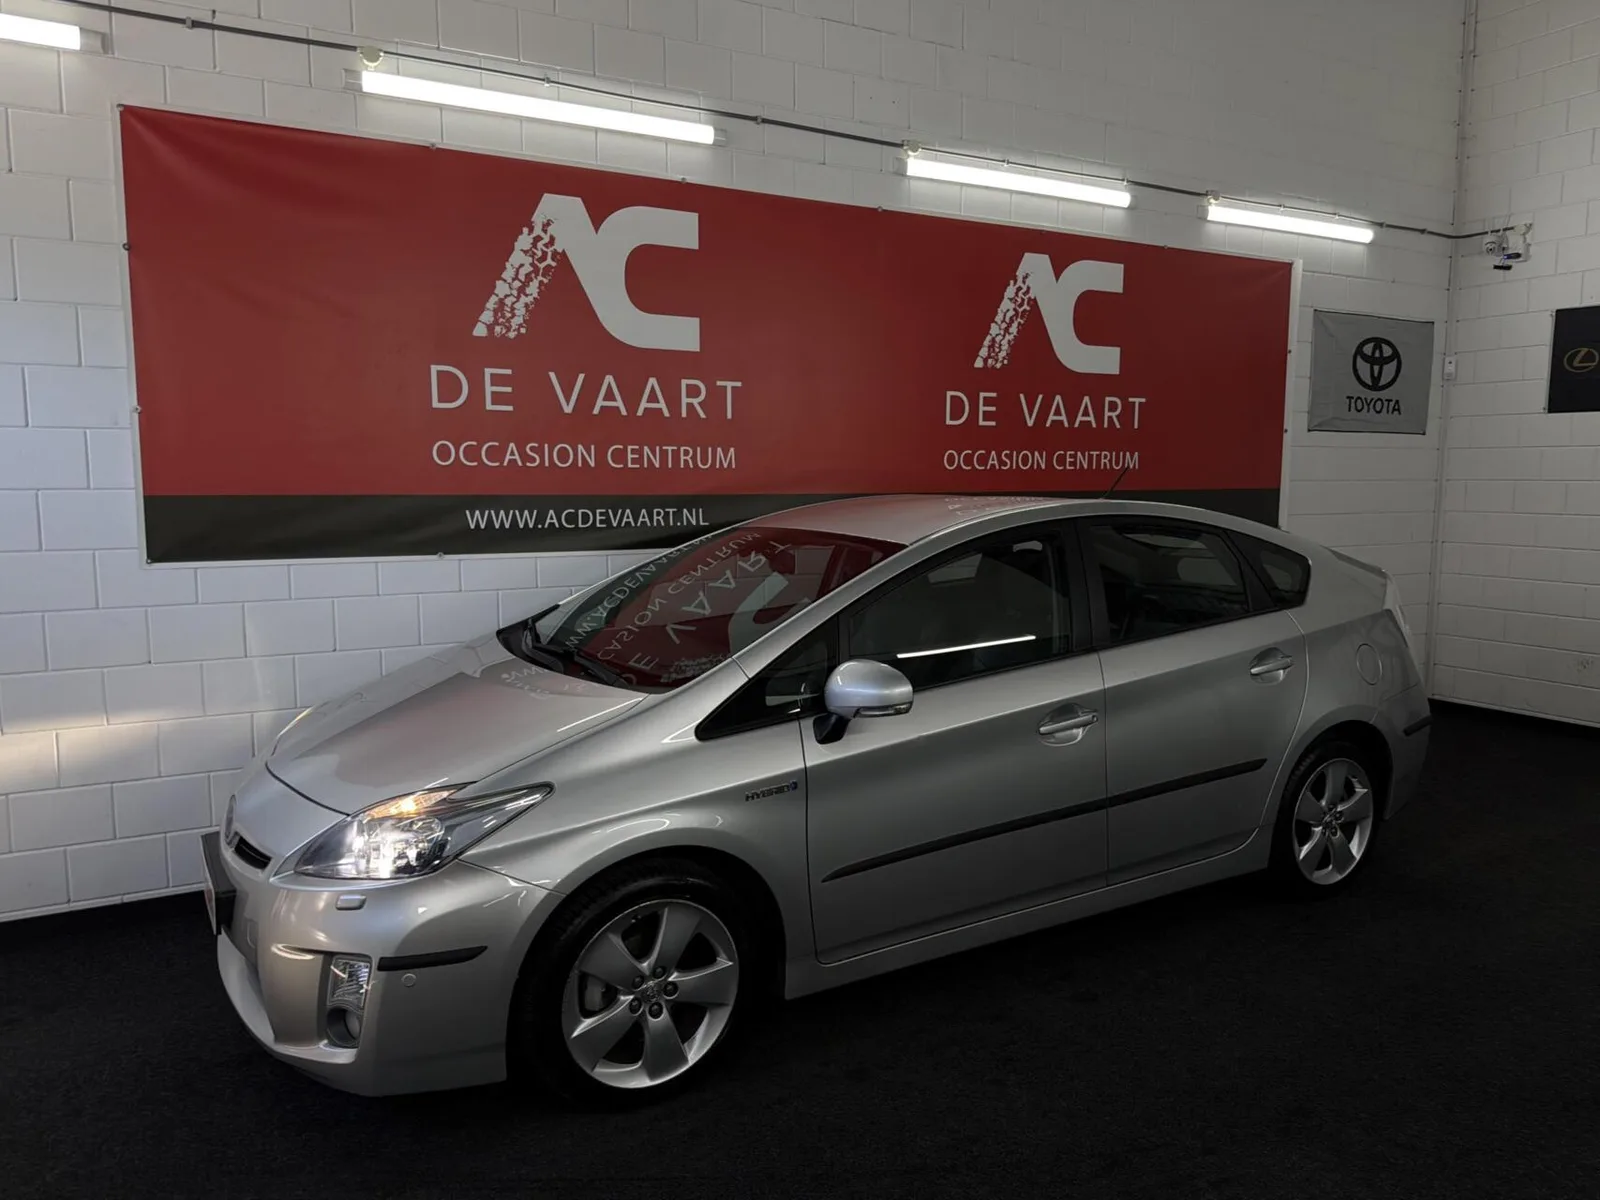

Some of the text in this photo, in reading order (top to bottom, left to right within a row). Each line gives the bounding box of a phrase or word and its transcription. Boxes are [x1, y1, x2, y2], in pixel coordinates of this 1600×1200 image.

[472, 193, 700, 352] AC
[973, 252, 1124, 375] AC
[430, 365, 742, 419] DE VAART
[1346, 396, 1402, 416] TOYOTA
[945, 391, 1146, 429] DE VAART
[432, 440, 736, 469] OCCASION CENTRUM
[943, 450, 1139, 470] OCCASION CENTRUM
[466, 508, 709, 529] WWW.ACDEVAART.NL
